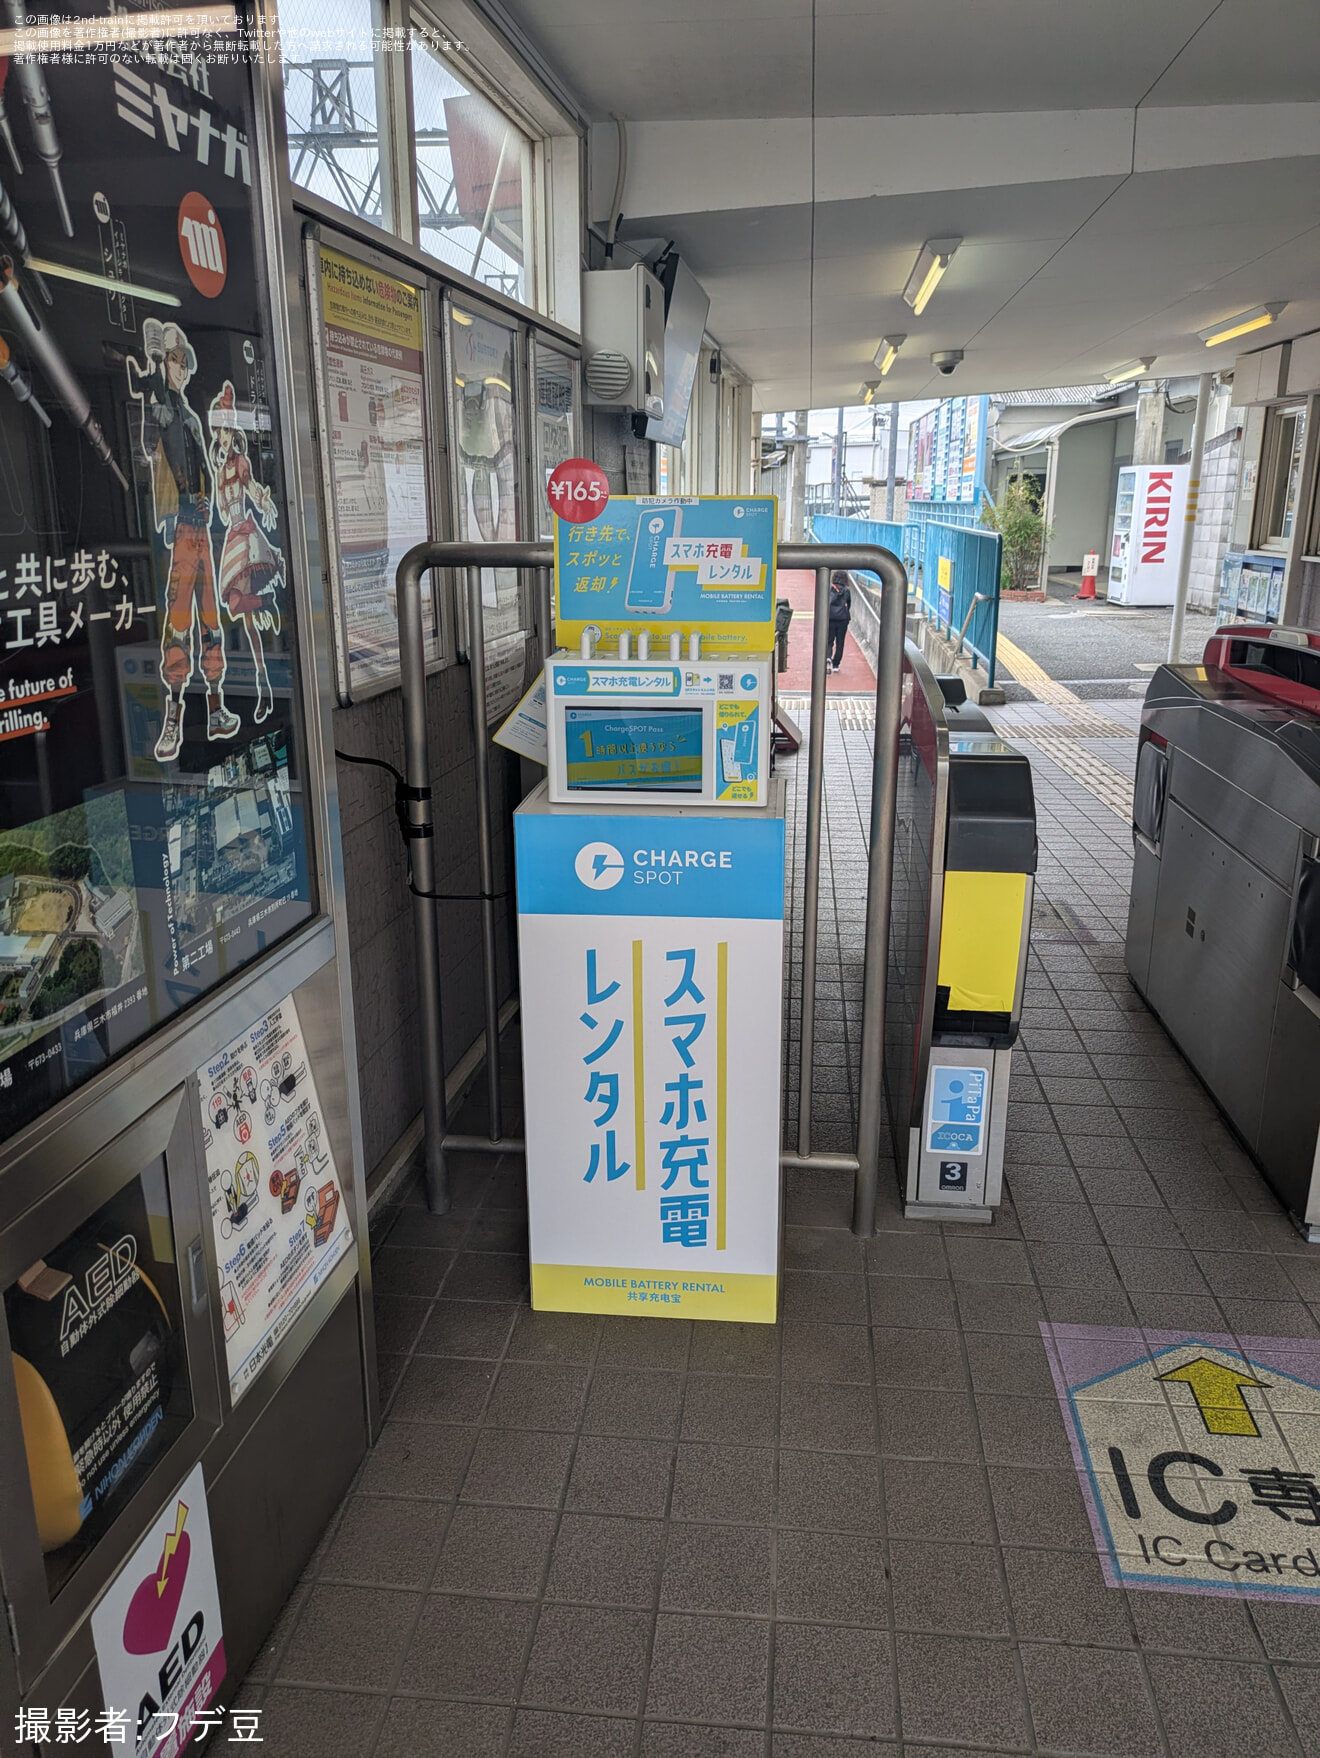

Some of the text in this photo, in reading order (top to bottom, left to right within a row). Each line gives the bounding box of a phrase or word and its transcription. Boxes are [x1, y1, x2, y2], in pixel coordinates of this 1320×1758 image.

[1141, 471, 1173, 563] KIRIN
[568, 525, 632, 543] 行き先で、
[565, 550, 623, 567] スポッと
[649, 535, 660, 569] CHARGE
[671, 543, 733, 559] スマホ充電
[708, 564, 753, 580] レンタル
[9, 675, 55, 701] future
[58, 667, 74, 688] of
[591, 675, 672, 688] スマホ充電レンタル
[604, 724, 664, 733] ChargeSPOT Pass
[632, 849, 733, 869] CHARGE
[632, 870, 684, 886] SPOT
[181, 938, 214, 973] 第二工場
[250, 1020, 269, 1043] Step3
[208, 1052, 230, 1078] Step2
[579, 948, 632, 1184] レンタル
[212, 1095, 222, 1109] 119
[659, 947, 711, 1249] スマホ充電
[965, 1072, 984, 1122] PiTaPa
[236, 1112, 247, 1127] AED
[267, 1124, 286, 1151] Step5
[937, 1131, 974, 1142] ICOCA
[944, 1163, 962, 1181] 3
[288, 1218, 306, 1248] Step7
[224, 1243, 246, 1274] Step6
[60, 1234, 138, 1341] AED
[583, 1277, 726, 1294] MOBILE BATTERY RENTAL
[627, 1291, 682, 1304] 共享充电宝
[74, 1372, 159, 1478] 緊急時以外 使用禁止
[86, 1465, 98, 1481] not
[97, 1451, 110, 1467] use
[109, 1427, 130, 1452] unless
[128, 1387, 161, 1429] emergency
[94, 1453, 128, 1500] NIHON
[1138, 1534, 1320, 1578] IC Card
[135, 1610, 205, 1752] AED
